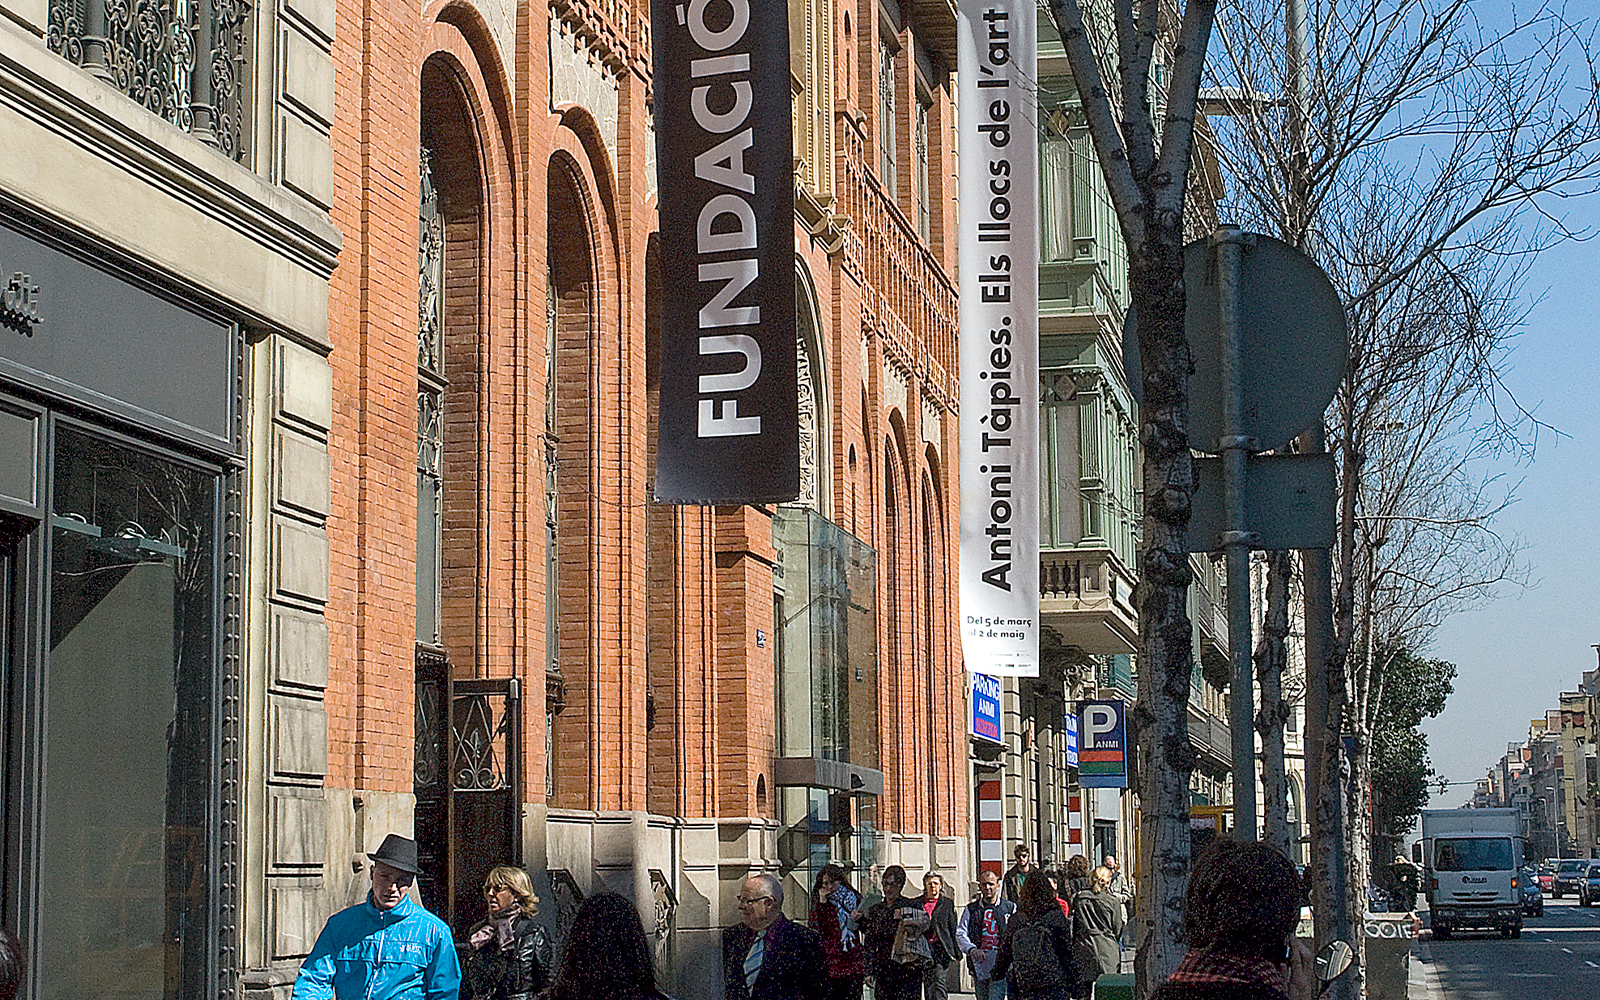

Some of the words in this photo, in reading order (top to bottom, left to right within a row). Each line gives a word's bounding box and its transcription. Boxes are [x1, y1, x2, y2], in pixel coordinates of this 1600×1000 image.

[977, 8, 1010, 88] l'art
[977, 99, 1011, 148] de
[675, 0, 762, 438] FUNDACIÓ
[977, 159, 1011, 242] llocs
[978, 254, 1012, 303] Els
[979, 316, 1021, 453] Tàpies.
[980, 464, 1012, 593] Antoni
[967, 615, 983, 625] Del
[985, 617, 992, 627] 5
[993, 616, 1005, 626] de
[1007, 618, 1032, 628] març
[979, 630, 985, 638] 2
[986, 629, 998, 638] de
[1000, 629, 1025, 641] maig
[972, 672, 1000, 701] PARKING
[978, 697, 996, 718] ANMI
[1083, 704, 1118, 749] P
[1095, 740, 1120, 749] ANMI
